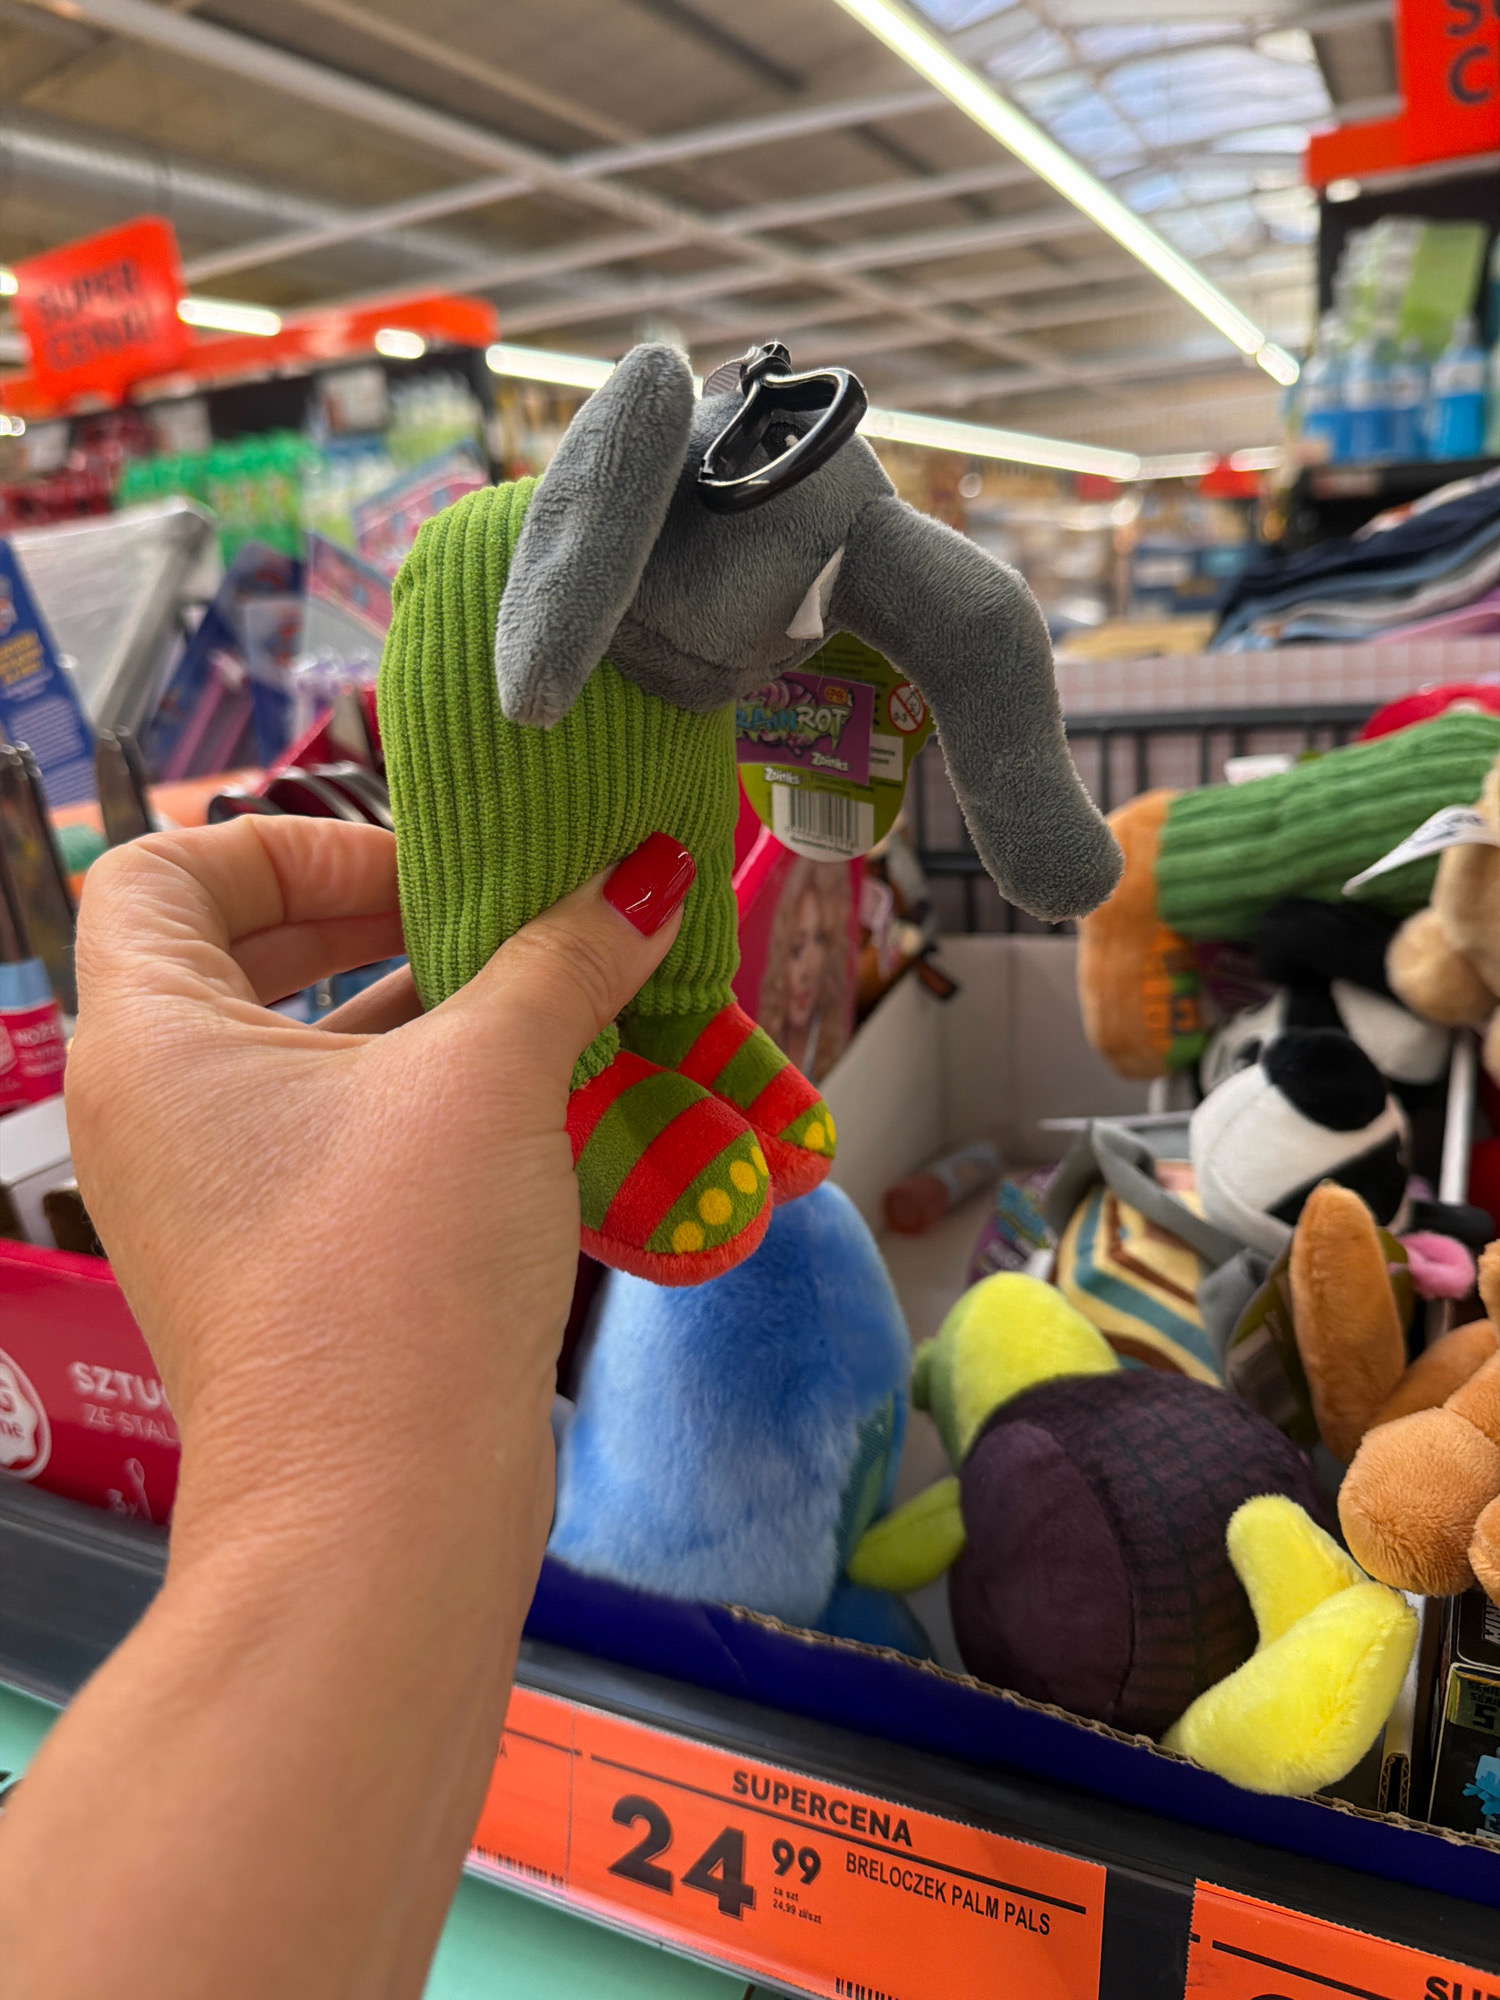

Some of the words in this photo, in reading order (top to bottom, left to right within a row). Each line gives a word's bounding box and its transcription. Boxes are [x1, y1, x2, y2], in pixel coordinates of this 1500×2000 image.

[736, 705, 850, 735] RAINROT
[732, 1770, 912, 1847] SUPERCENA
[607, 1793, 756, 1921] 24
[772, 1838, 821, 1885] 99
[846, 1852, 946, 1903] BRELOCZEK
[951, 1885, 999, 1920] PALM
[1004, 1902, 1050, 1935] PALS
[772, 1898, 796, 1915] 24,99
